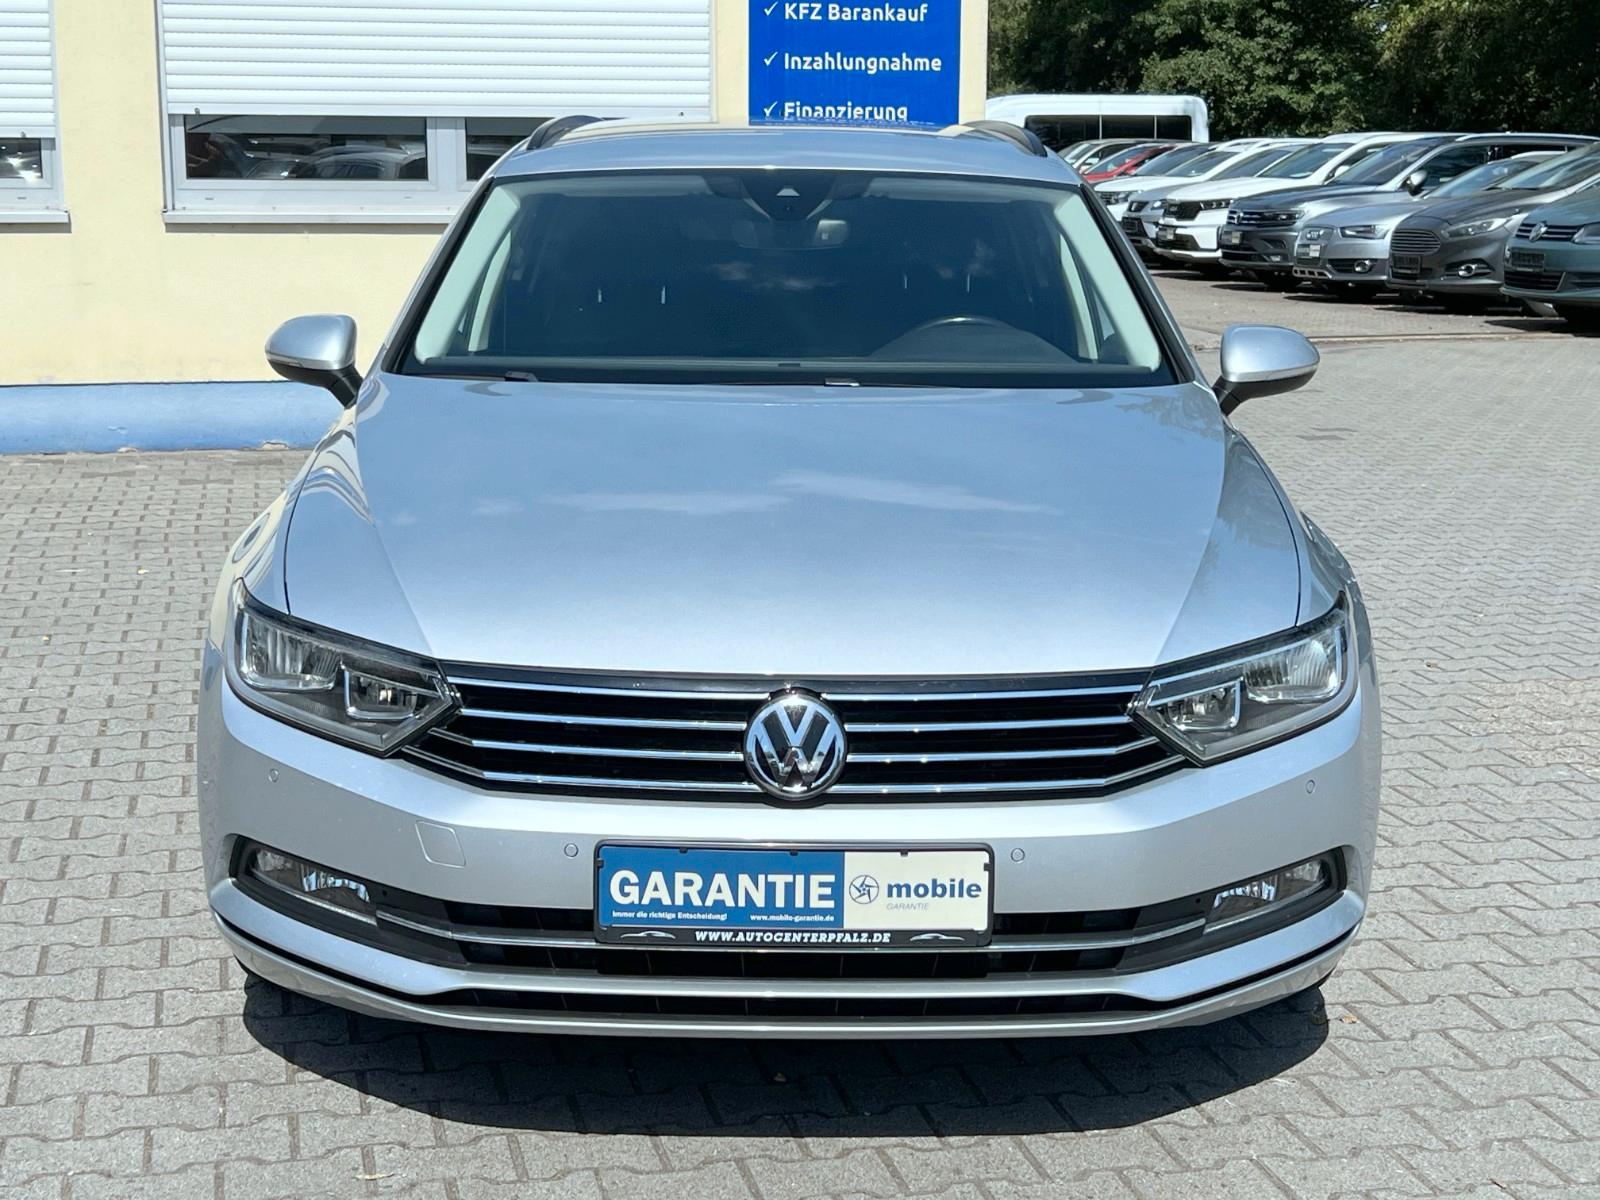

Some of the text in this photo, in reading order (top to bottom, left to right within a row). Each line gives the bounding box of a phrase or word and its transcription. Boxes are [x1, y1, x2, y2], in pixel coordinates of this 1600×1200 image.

[784, 3, 928, 22] KFZ Barankauf
[784, 52, 942, 74] Inzahlungnahme
[784, 101, 908, 121] Finanzierung
[609, 869, 836, 909] GARANTIE
[886, 878, 982, 899] mobile
[612, 910, 728, 921] Immer die richtige Entscheidung!
[886, 902, 930, 911] GARANTIE
[749, 913, 835, 922] www.mobile-garantie.de
[695, 930, 891, 944] WWW.AUTOCENTERPFALZ.DE
